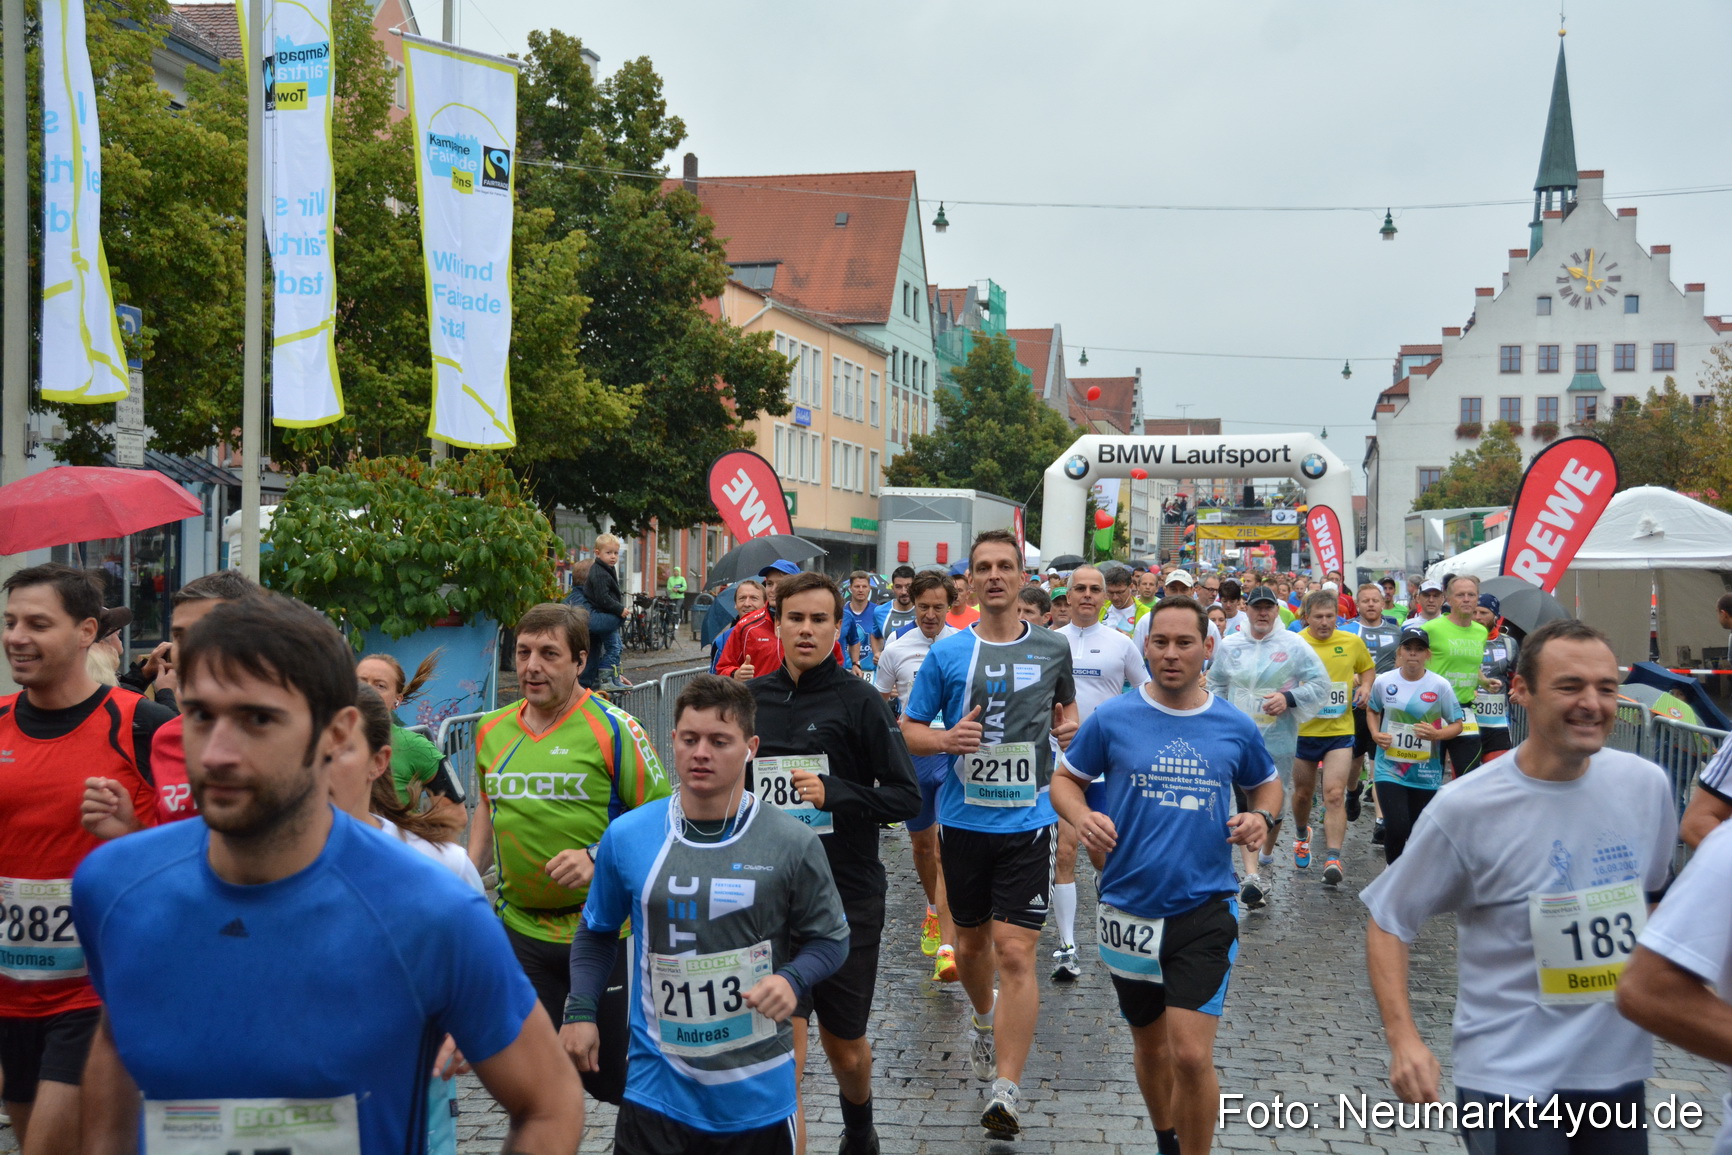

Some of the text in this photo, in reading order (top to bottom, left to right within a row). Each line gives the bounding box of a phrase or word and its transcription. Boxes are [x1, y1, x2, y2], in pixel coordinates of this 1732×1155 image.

[1098, 444, 1292, 468] BMW Laufsport
[1511, 457, 1603, 588] REWE
[1236, 528, 1260, 537] ZIEL
[1330, 690, 1345, 705] 96
[1323, 706, 1337, 714] Hans
[1476, 701, 1504, 715] 3039
[606, 706, 665, 787] BOCK
[996, 745, 1029, 753] BOCK
[1396, 732, 1423, 749] 104
[783, 758, 820, 768] BOCK
[1396, 750, 1418, 759] Sophia
[971, 758, 1030, 782] 2210
[485, 772, 591, 800] BOCK
[1130, 773, 1152, 788] 13.
[1148, 773, 1193, 785] Neumarkter
[979, 787, 1021, 798] Christian
[21, 883, 73, 896] BOCK
[1586, 885, 1637, 906] BOCK
[1099, 916, 1155, 955] 3042
[1561, 911, 1637, 961] 183
[686, 954, 740, 972] BOCK
[661, 975, 743, 1018] 2113
[677, 1026, 730, 1043] Andreas
[236, 1105, 334, 1128] BOCK
